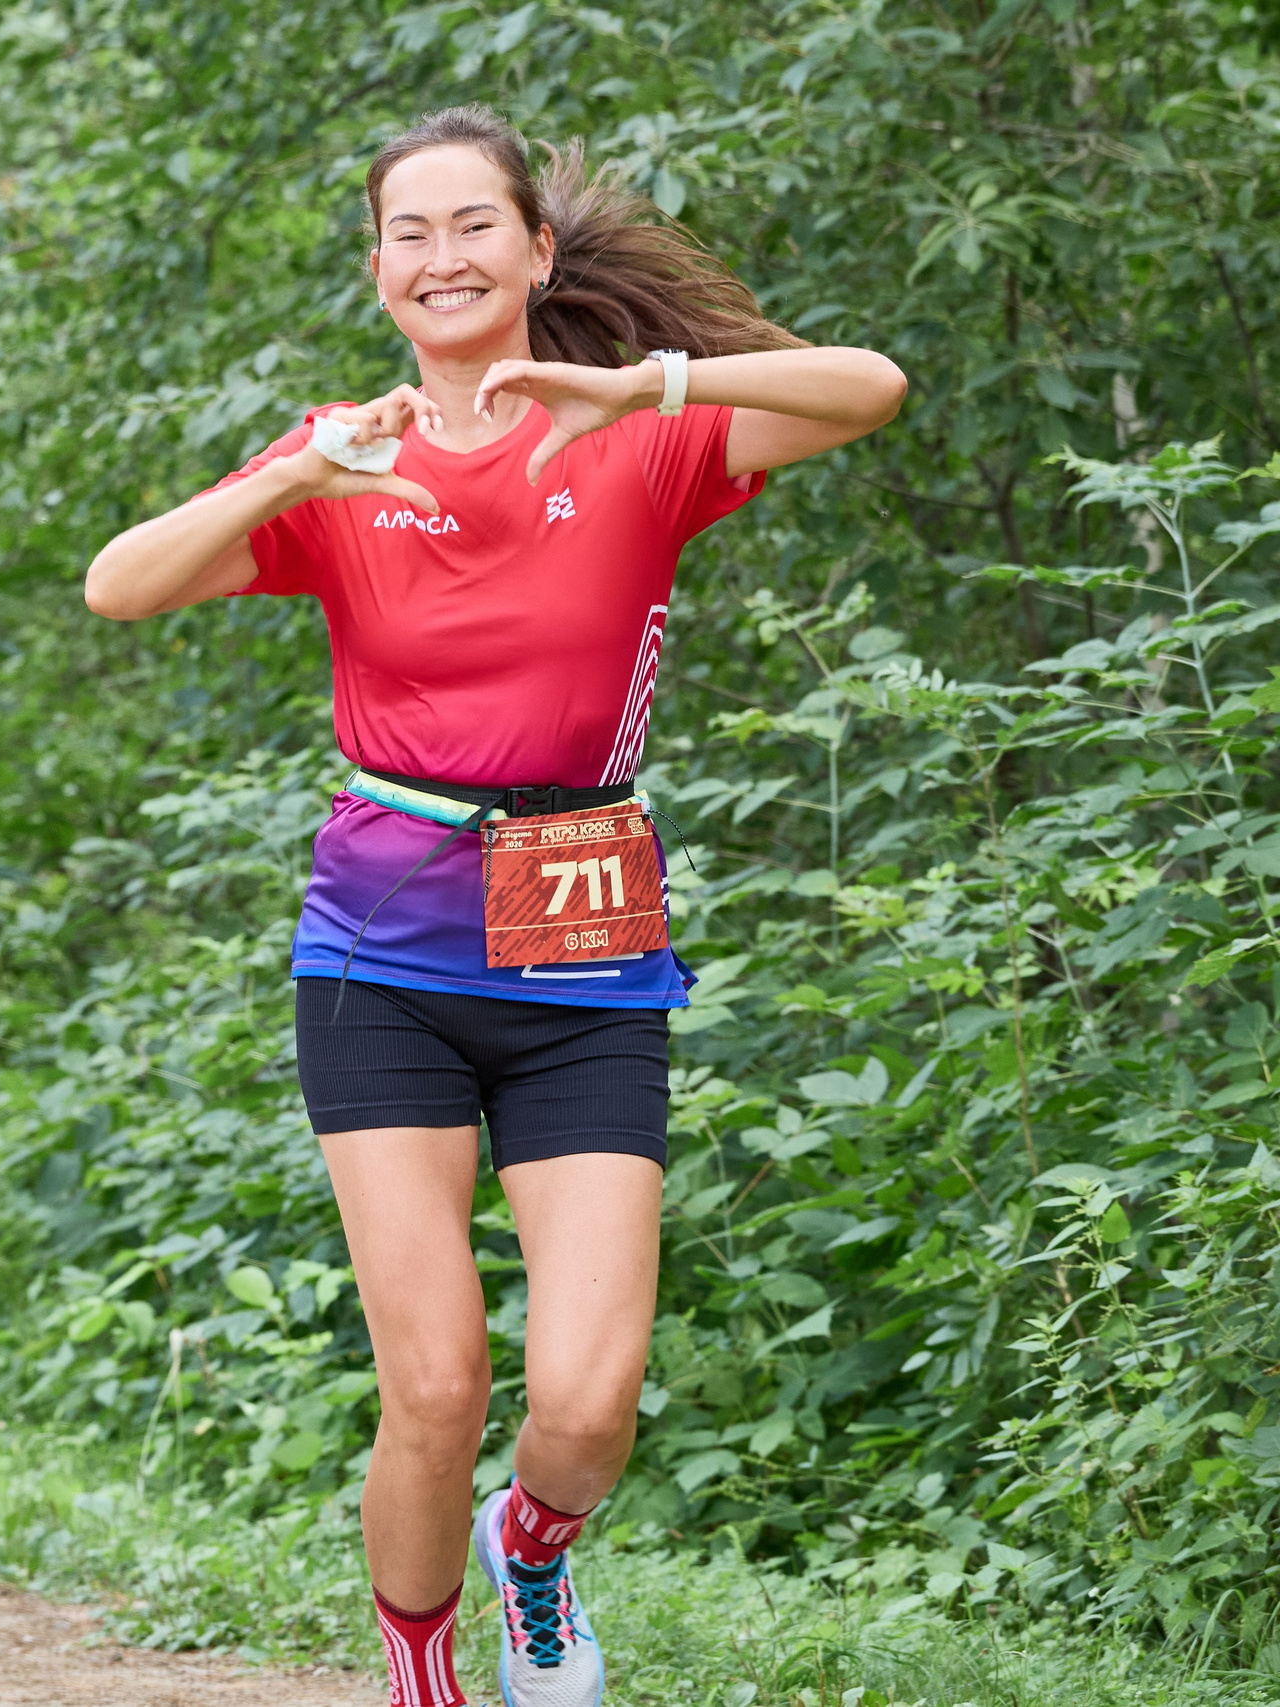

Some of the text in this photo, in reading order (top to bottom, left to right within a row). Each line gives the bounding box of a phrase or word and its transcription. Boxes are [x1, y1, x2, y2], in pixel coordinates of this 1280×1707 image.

[541, 820, 615, 840] РЕТРО КРОСС
[541, 855, 625, 916] 711
[564, 933, 579, 950] 6
